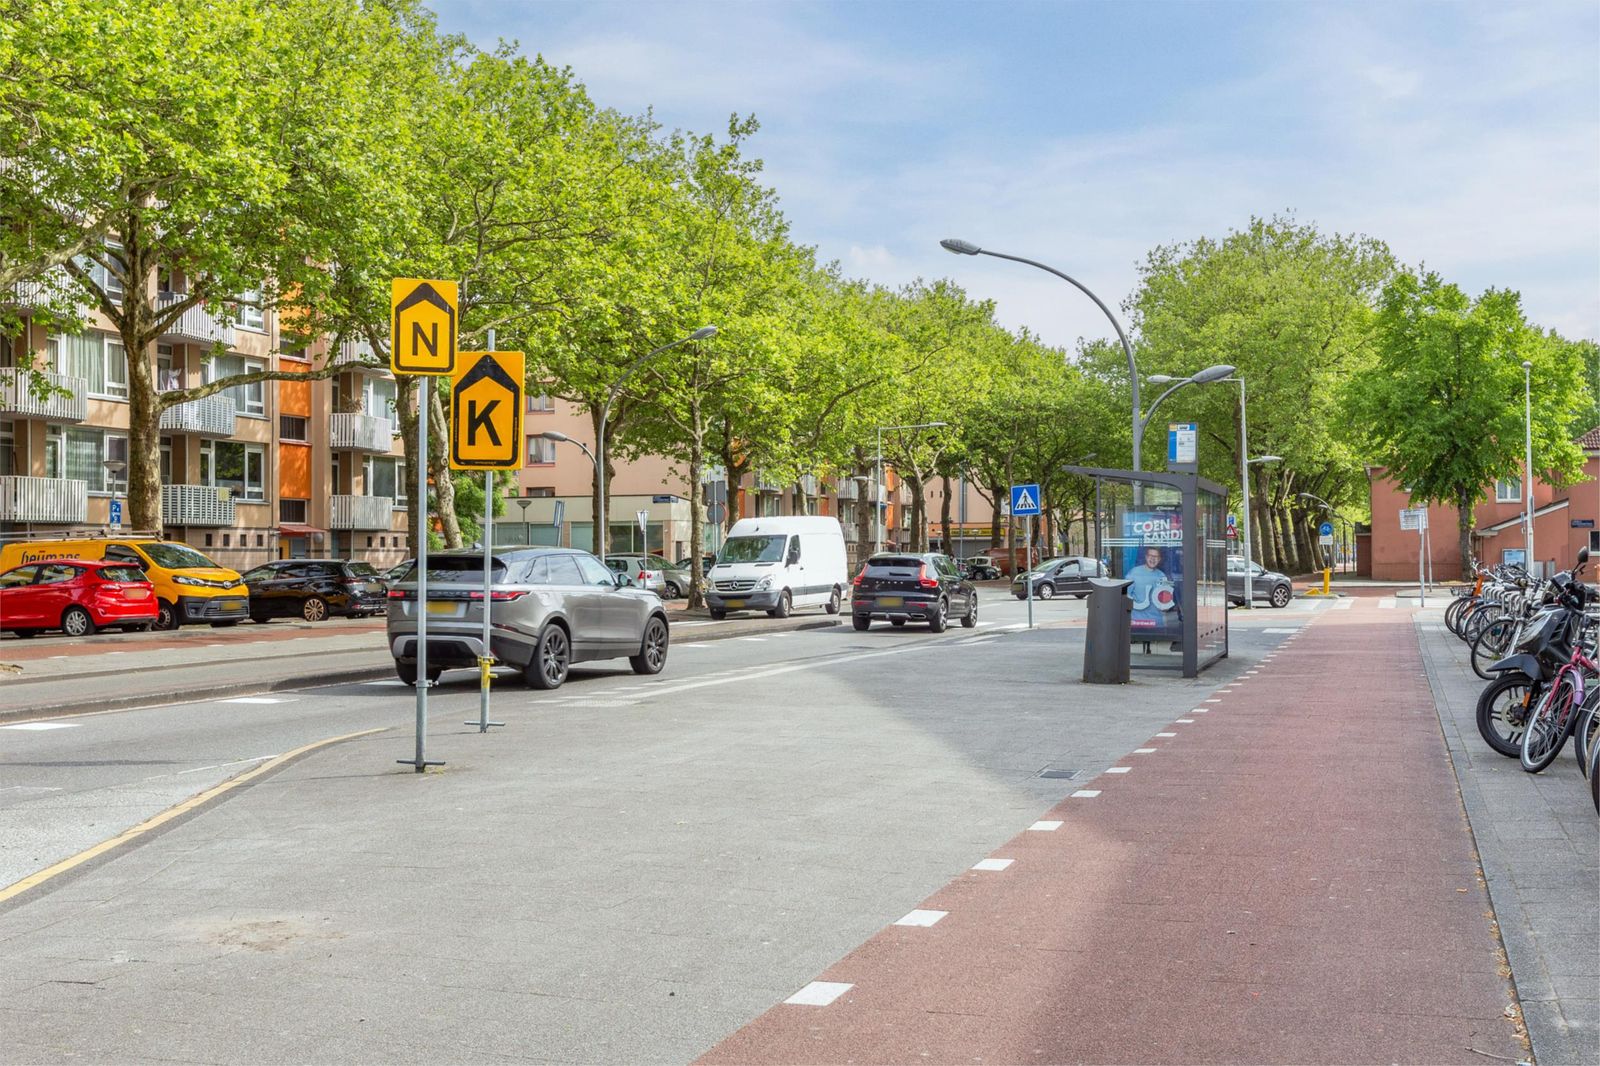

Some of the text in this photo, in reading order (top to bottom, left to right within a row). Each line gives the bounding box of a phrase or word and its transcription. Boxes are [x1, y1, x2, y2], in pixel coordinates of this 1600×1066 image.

[412, 321, 438, 357] N
[467, 400, 502, 446] K
[1133, 518, 1170, 533] COEN
